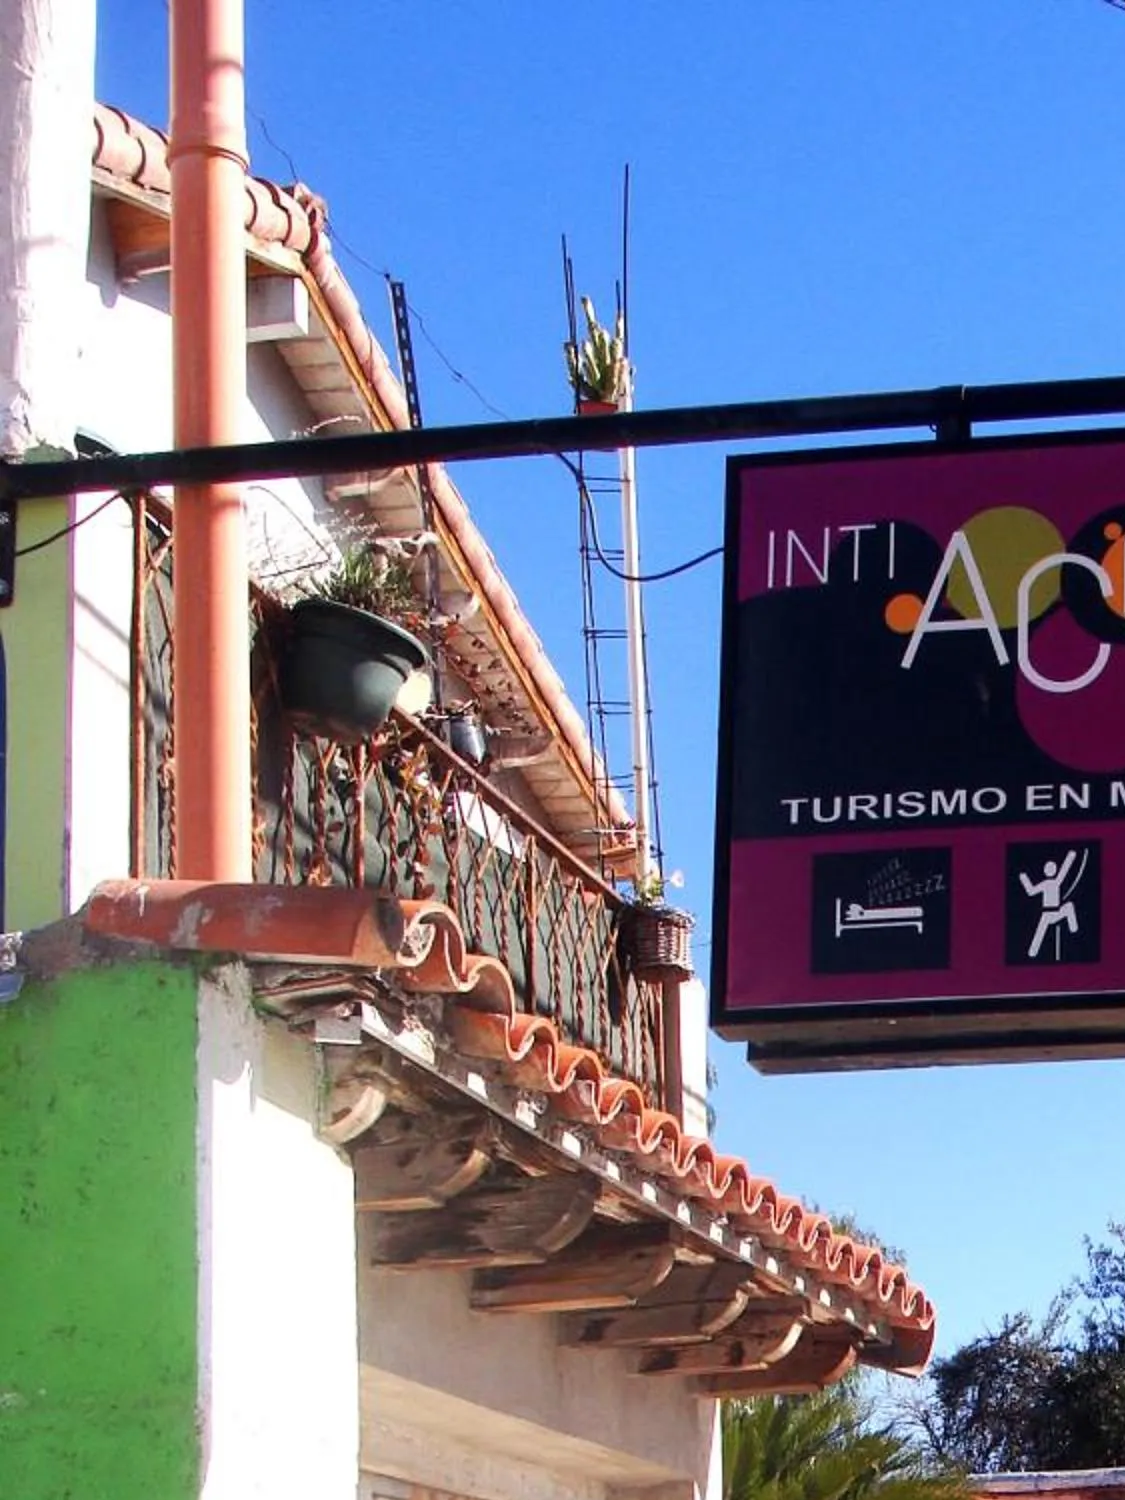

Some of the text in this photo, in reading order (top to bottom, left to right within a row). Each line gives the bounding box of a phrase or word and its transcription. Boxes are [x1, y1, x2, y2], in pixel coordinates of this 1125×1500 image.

[767, 522, 896, 588] INTI
[781, 787, 1007, 825] TURISMO
[1025, 783, 1089, 811] EN
